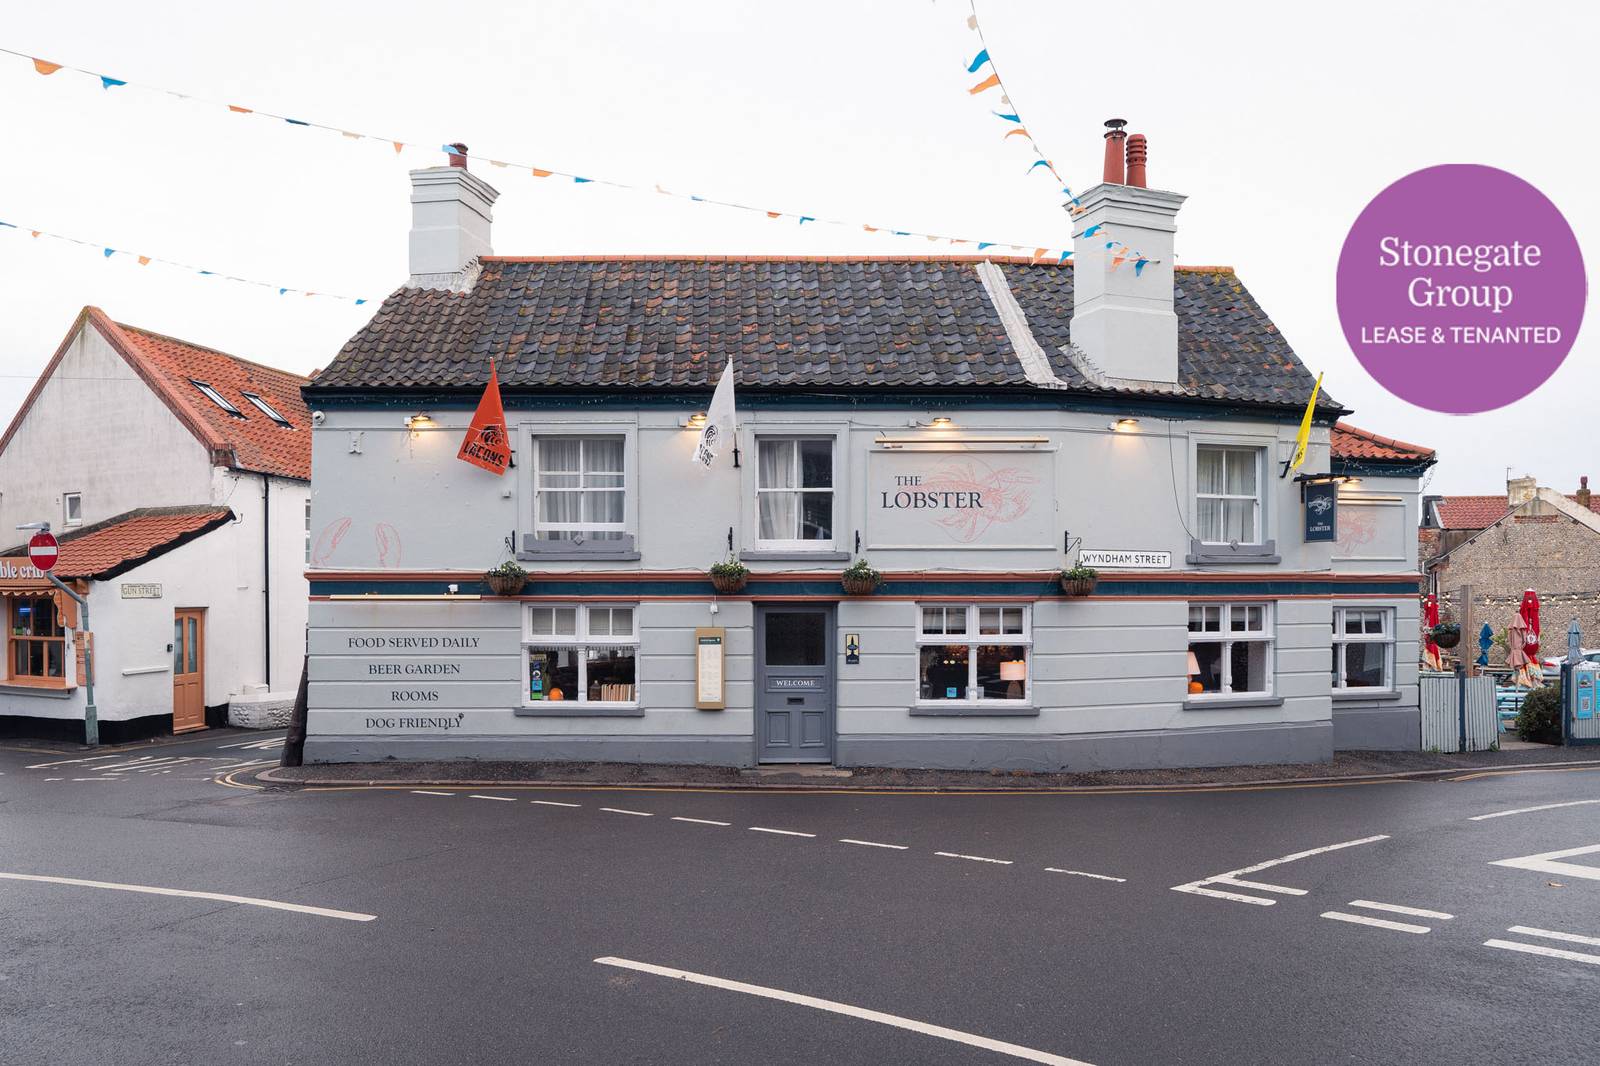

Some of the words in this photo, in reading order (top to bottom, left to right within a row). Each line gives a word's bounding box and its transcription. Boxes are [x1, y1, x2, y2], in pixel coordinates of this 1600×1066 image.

[463, 441, 505, 466] LACONS
[895, 475, 922, 486] THE
[881, 491, 984, 509] LOBSTER
[1082, 553, 1132, 564] WYNDHAM
[1134, 554, 1167, 564] STREET
[138, 587, 160, 596] STREET
[348, 637, 386, 649] FOOD
[388, 637, 439, 649] SERVED
[442, 637, 480, 649] DAILY
[368, 664, 402, 675] BEER
[404, 664, 461, 675] GARDEN
[776, 679, 816, 687] WELCOME
[391, 691, 439, 702] ROOMS
[366, 718, 396, 729] DOG
[399, 715, 463, 730] FRIENDLY
